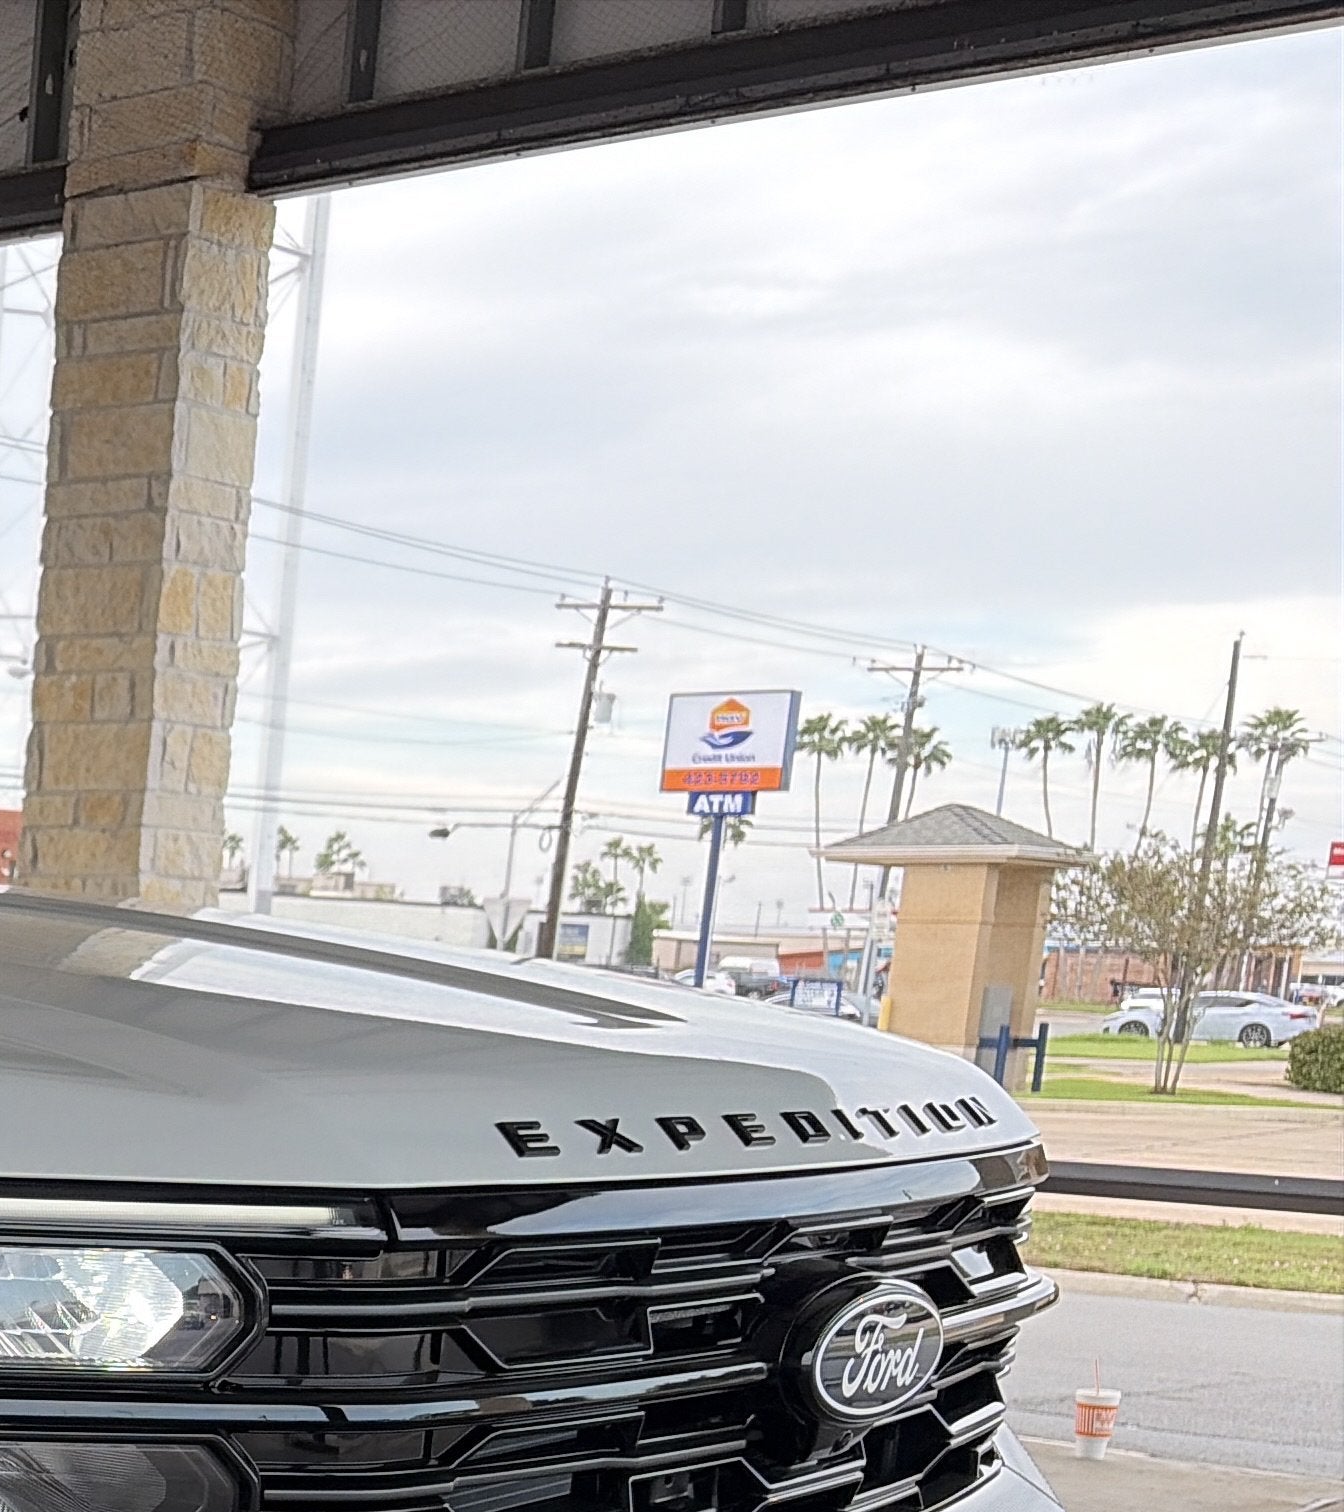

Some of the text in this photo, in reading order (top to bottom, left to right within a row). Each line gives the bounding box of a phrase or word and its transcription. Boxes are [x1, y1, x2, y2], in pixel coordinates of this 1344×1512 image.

[692, 753, 755, 764] Credit Union
[693, 795, 743, 813] ATM
[495, 1096, 997, 1158] EXPEDITION
[843, 1313, 921, 1397] Ford
